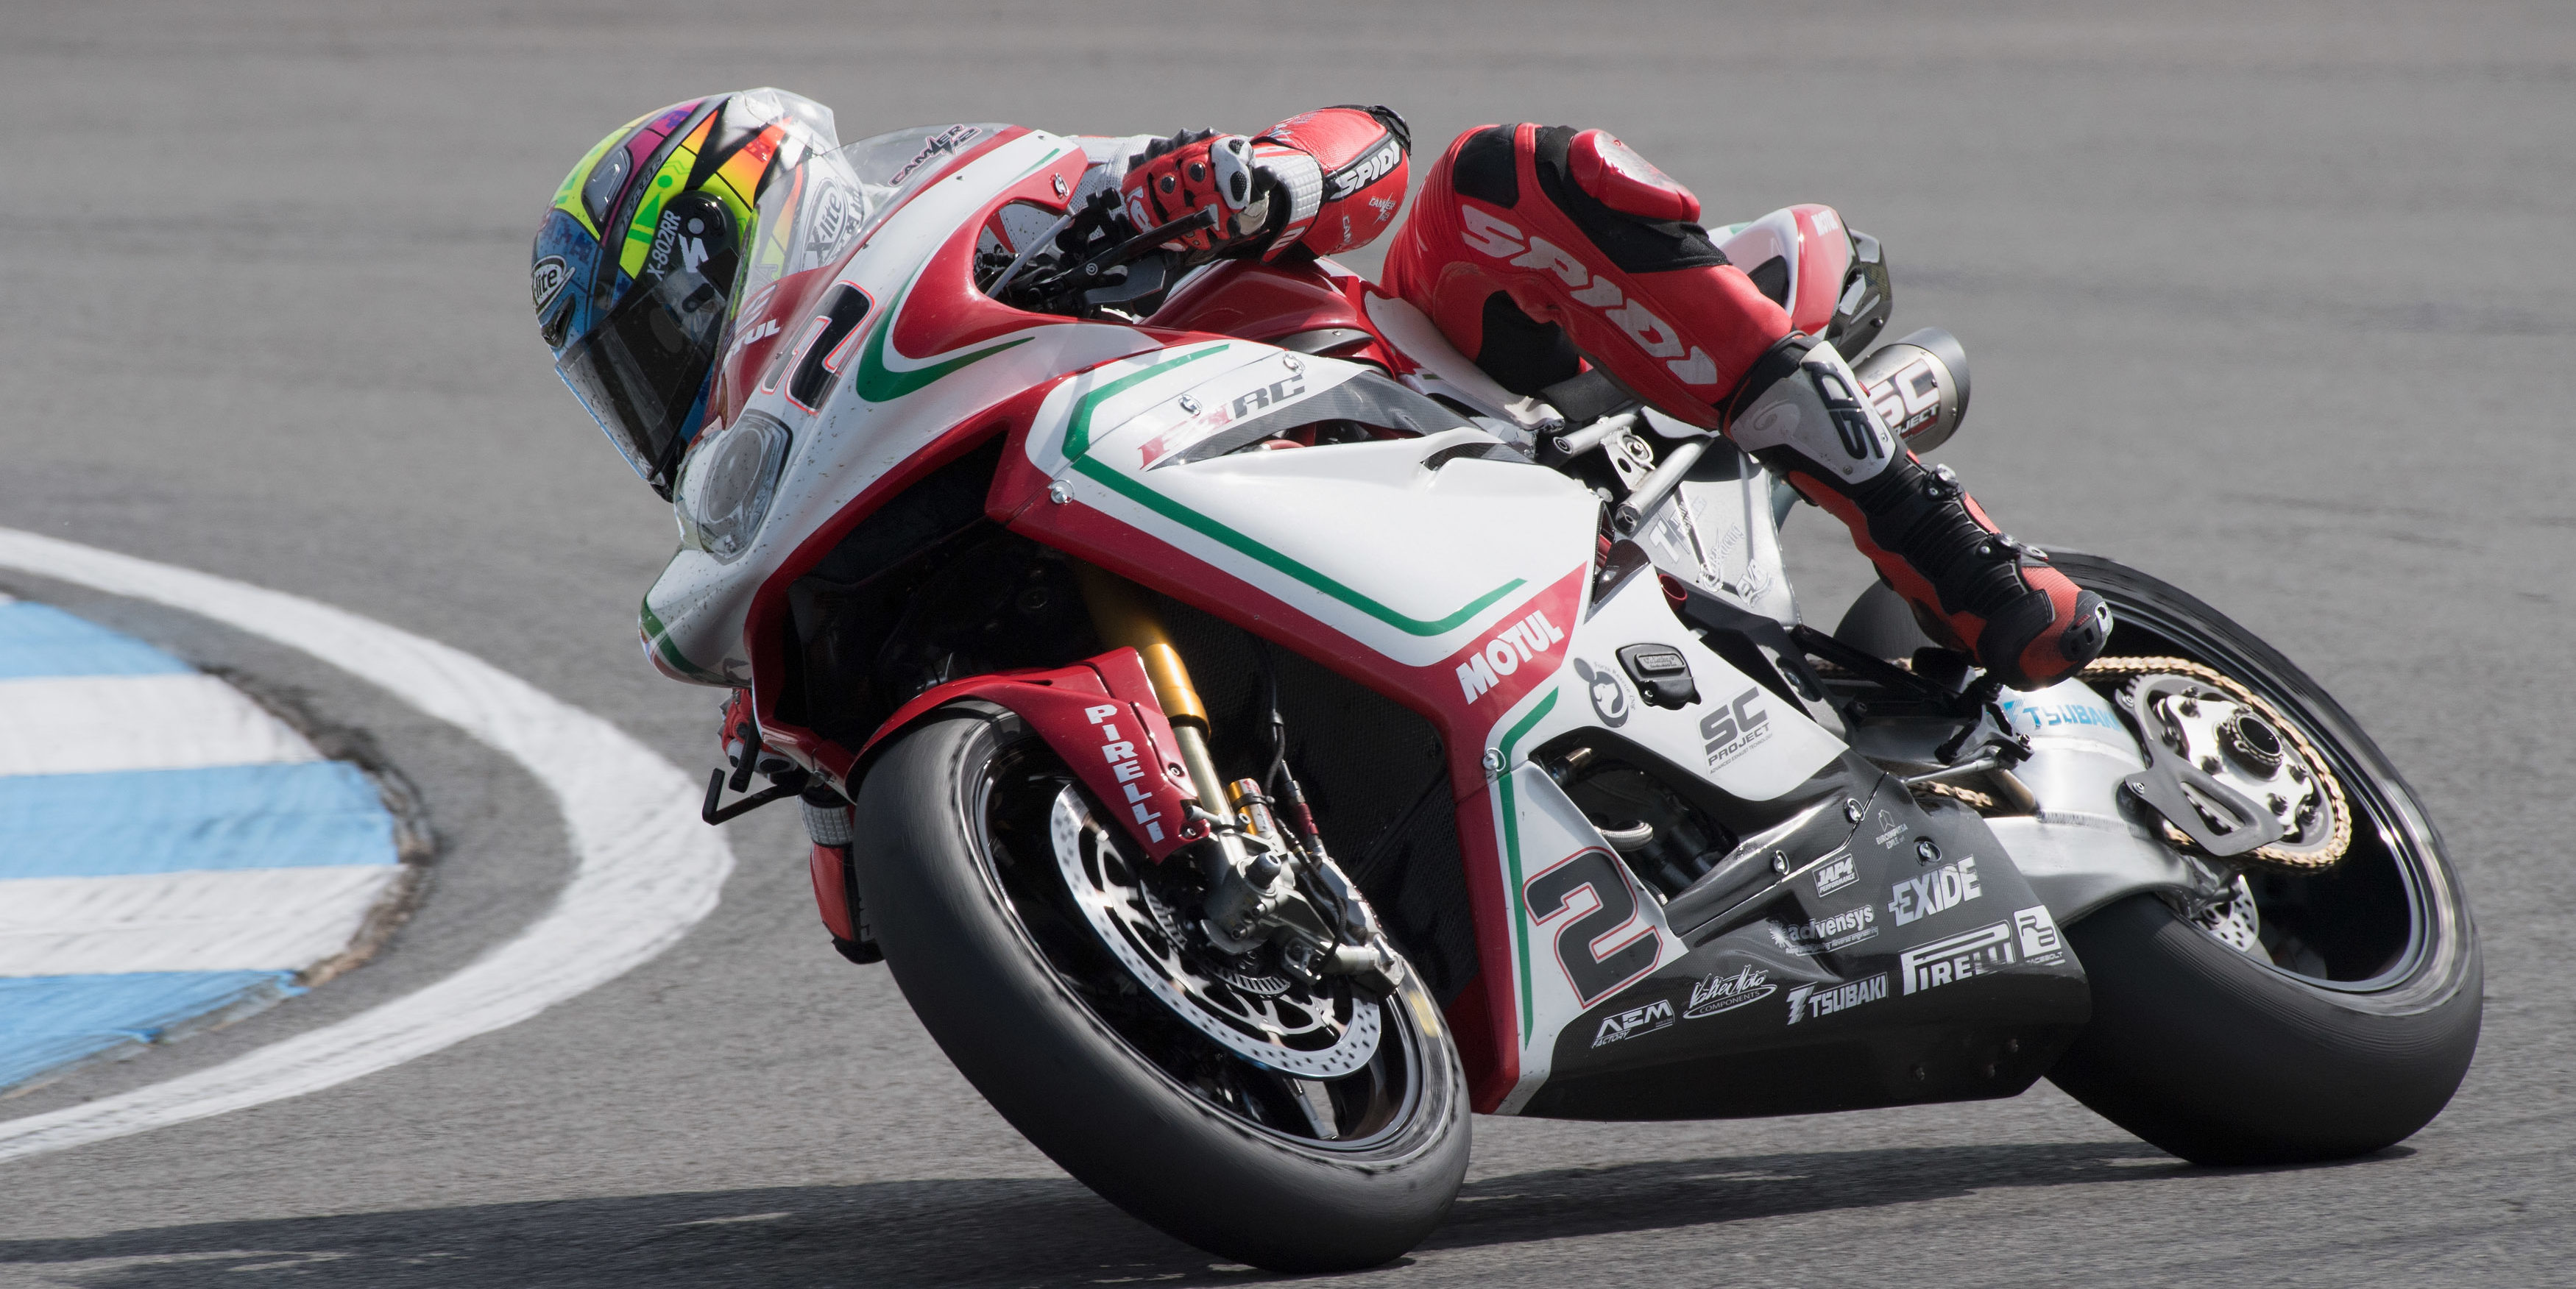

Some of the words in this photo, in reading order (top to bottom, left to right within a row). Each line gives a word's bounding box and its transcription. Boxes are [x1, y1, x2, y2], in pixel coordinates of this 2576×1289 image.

[1340, 141, 1400, 196] SPIDI
[647, 210, 681, 282] X-802RR
[807, 193, 842, 264] X-lite
[532, 269, 558, 310] -lite
[1460, 205, 1718, 385] SPIDI
[729, 319, 780, 358] TUL
[1456, 610, 1564, 705] MOTUL
[1699, 686, 1768, 756] SC
[1708, 722, 1769, 766] PROJECT
[1085, 704, 1165, 843] PIRELLI
[1788, 904, 1875, 942] advensys
[1889, 855, 1982, 926] EXIDE
[1522, 846, 1663, 1009] 2
[1900, 923, 2015, 995] PIRELLI
[1699, 990, 1761, 1014] COMPONENTS
[1808, 973, 1888, 1018] TSUBAKI
[1592, 1029, 1632, 1049] FACTORY
